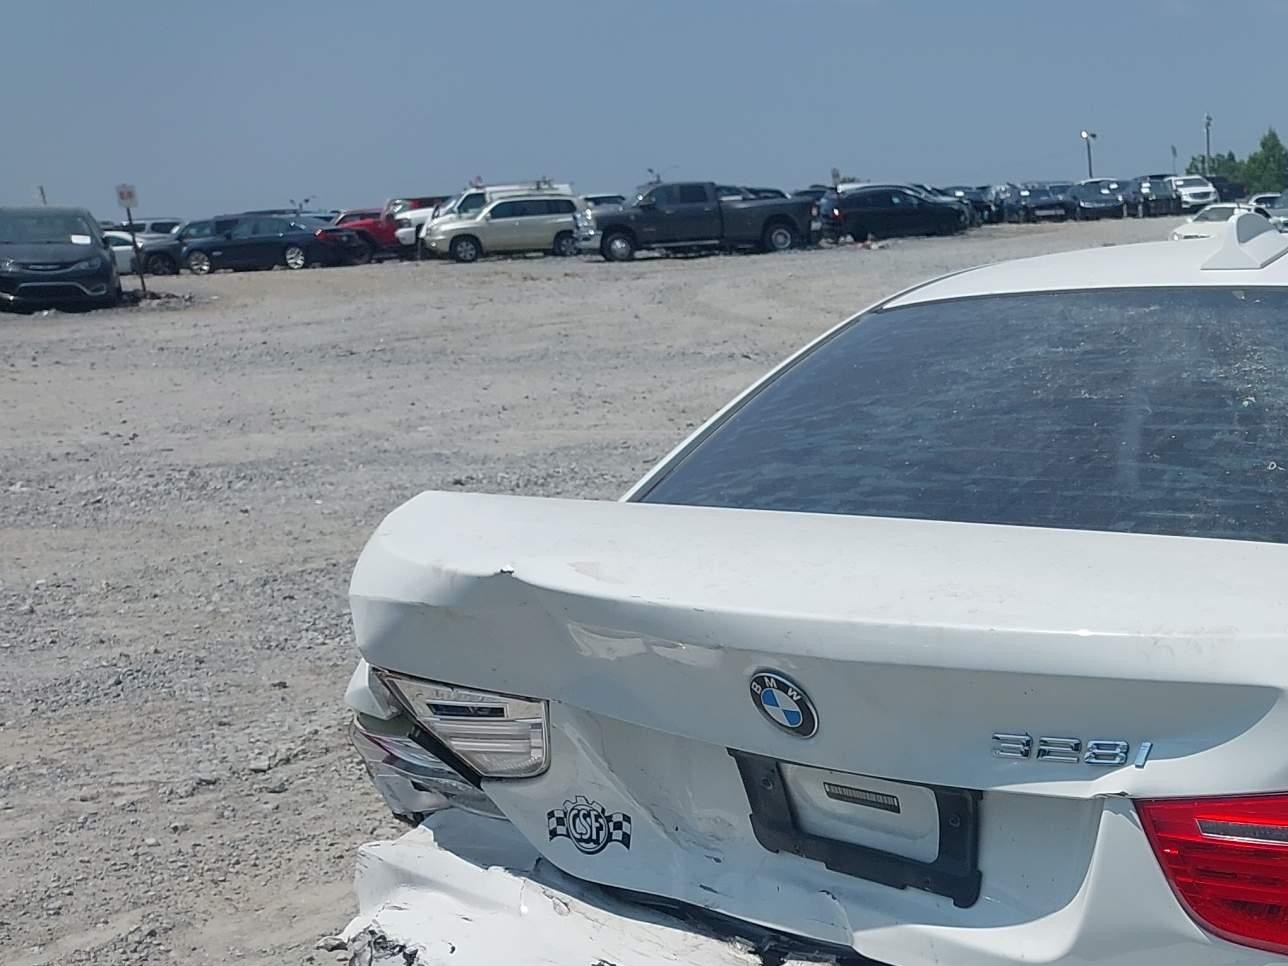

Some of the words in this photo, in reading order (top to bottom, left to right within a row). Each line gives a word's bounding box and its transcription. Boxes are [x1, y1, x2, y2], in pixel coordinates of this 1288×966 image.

[751, 676, 801, 701] BMW
[992, 732, 1153, 769] 328i
[569, 807, 601, 841] CSF
